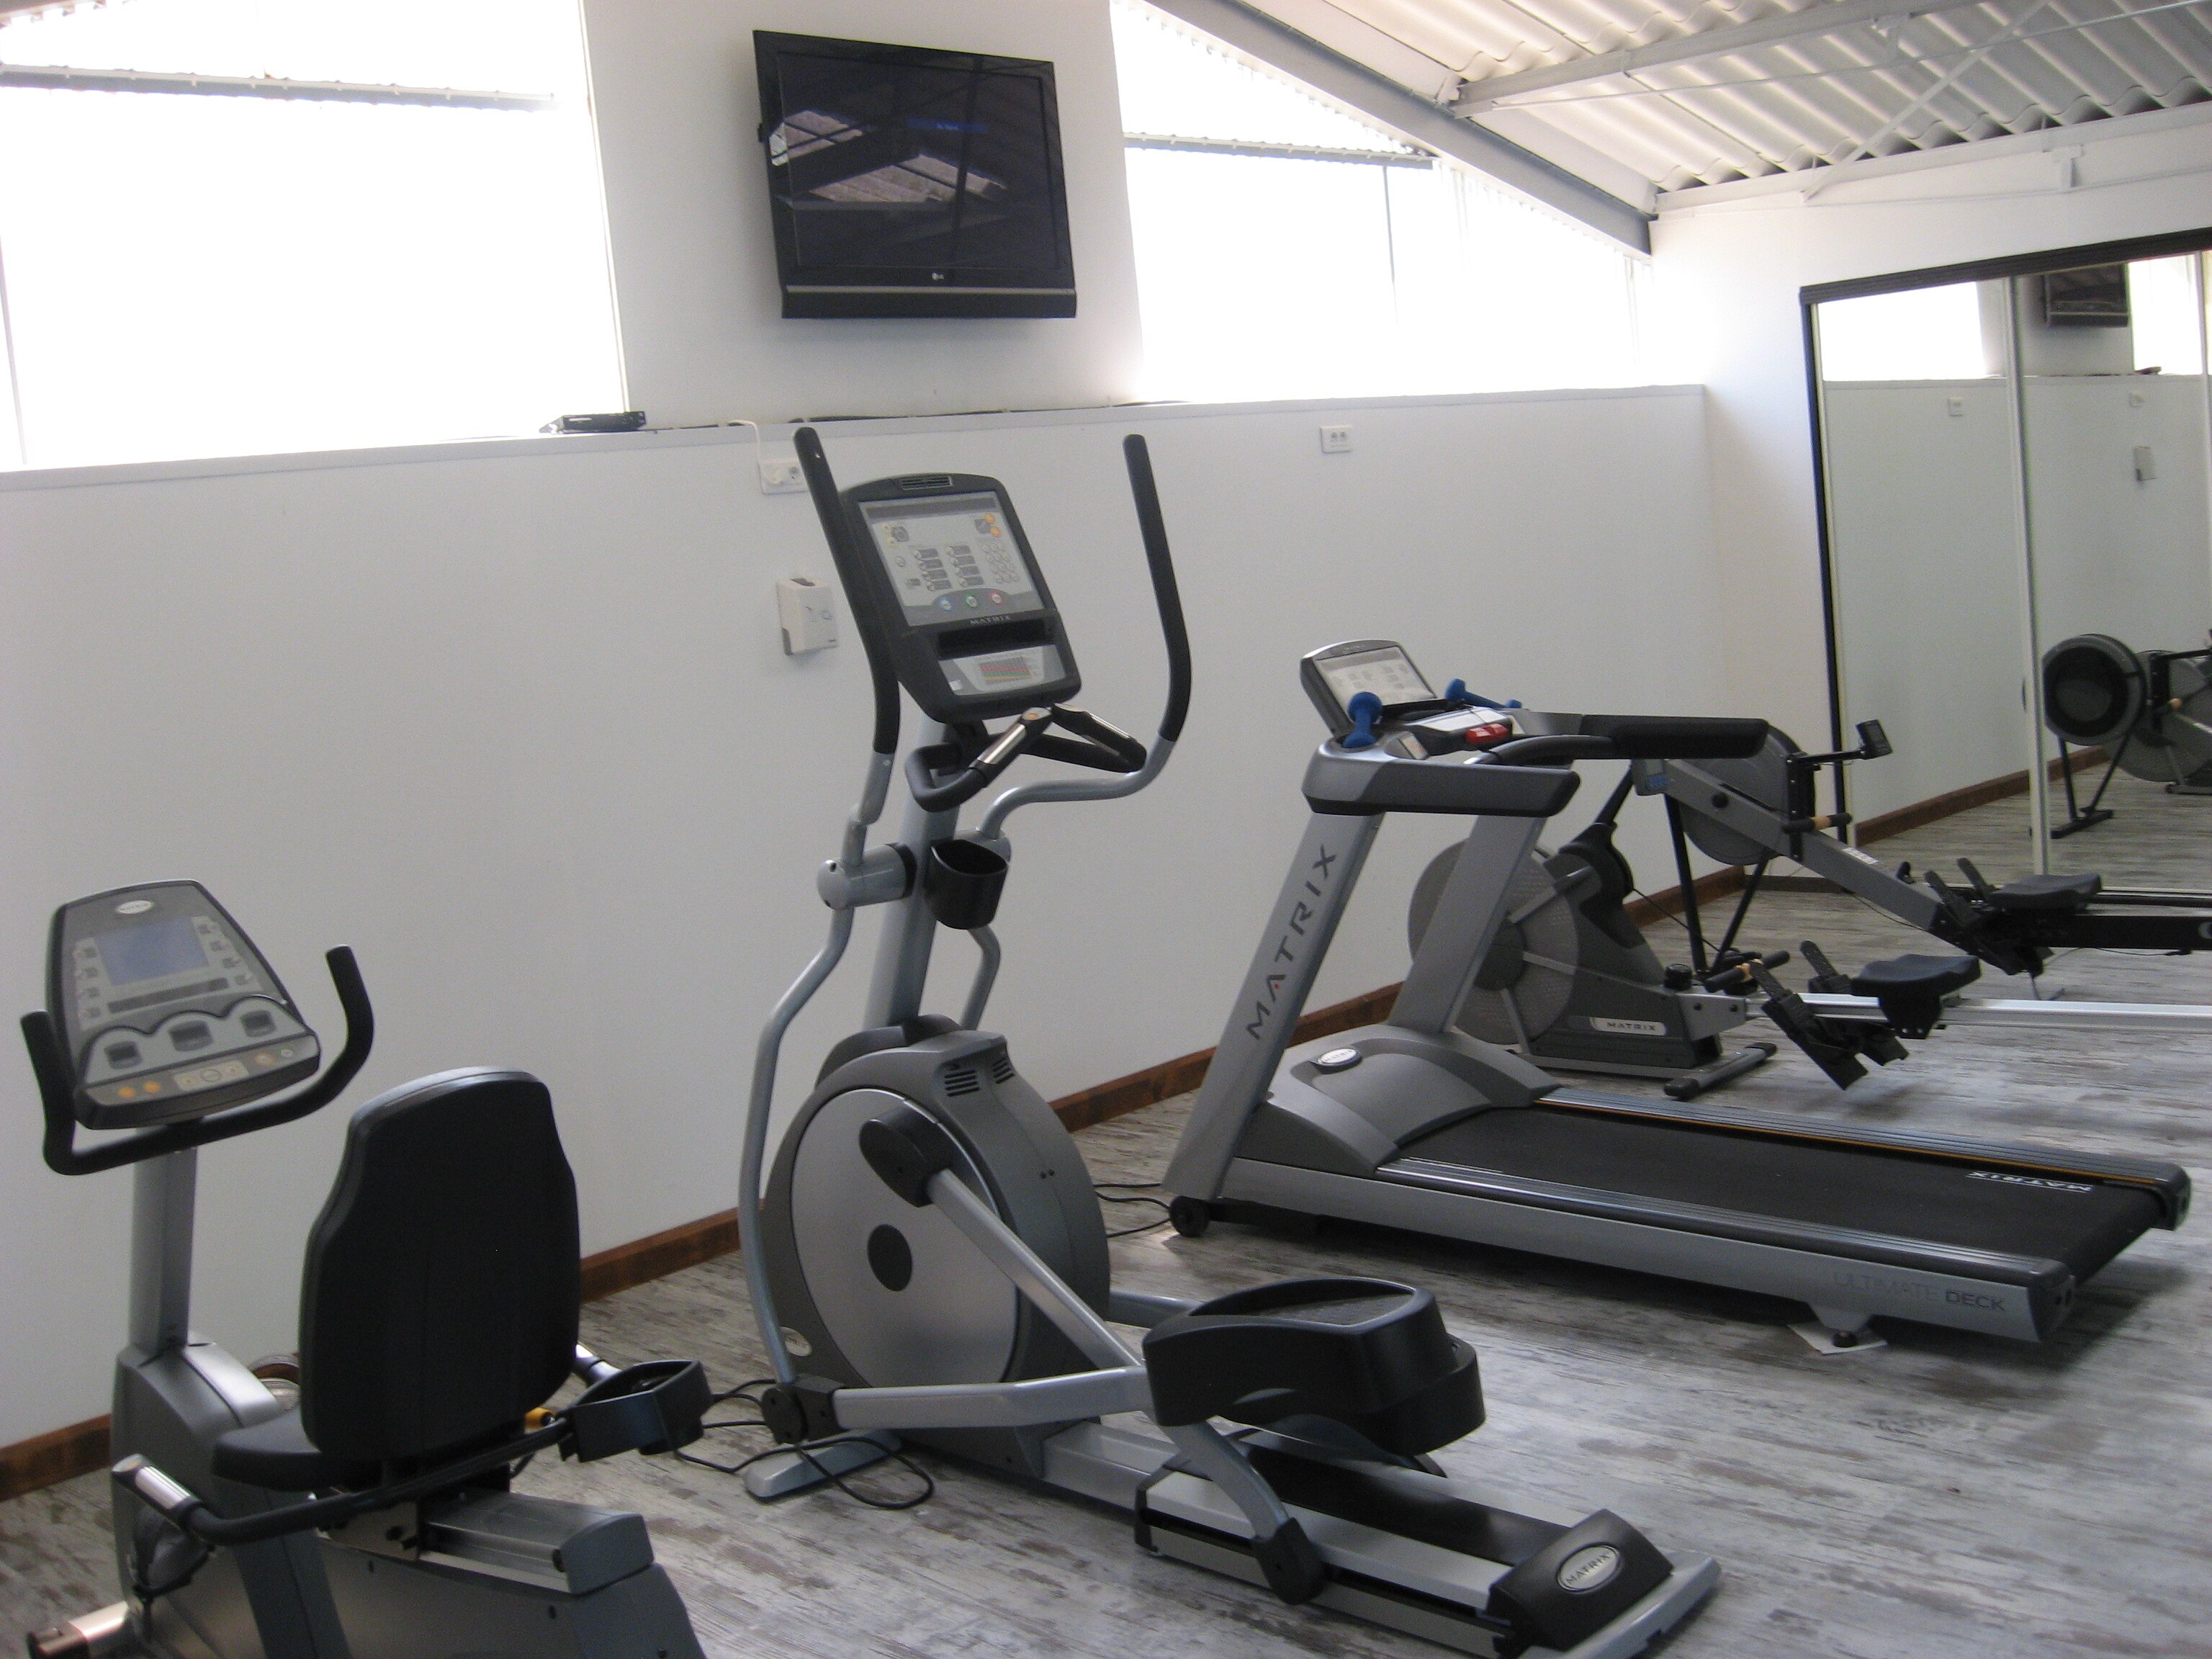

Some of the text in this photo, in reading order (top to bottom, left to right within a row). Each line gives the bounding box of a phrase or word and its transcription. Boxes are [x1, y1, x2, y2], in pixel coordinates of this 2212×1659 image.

[1245, 843, 1336, 1040] MATRIX
[1606, 1021, 1656, 1031] MATRIX
[1945, 1289, 2005, 1311] DECK
[1565, 1553, 1611, 1584] MATRIX
